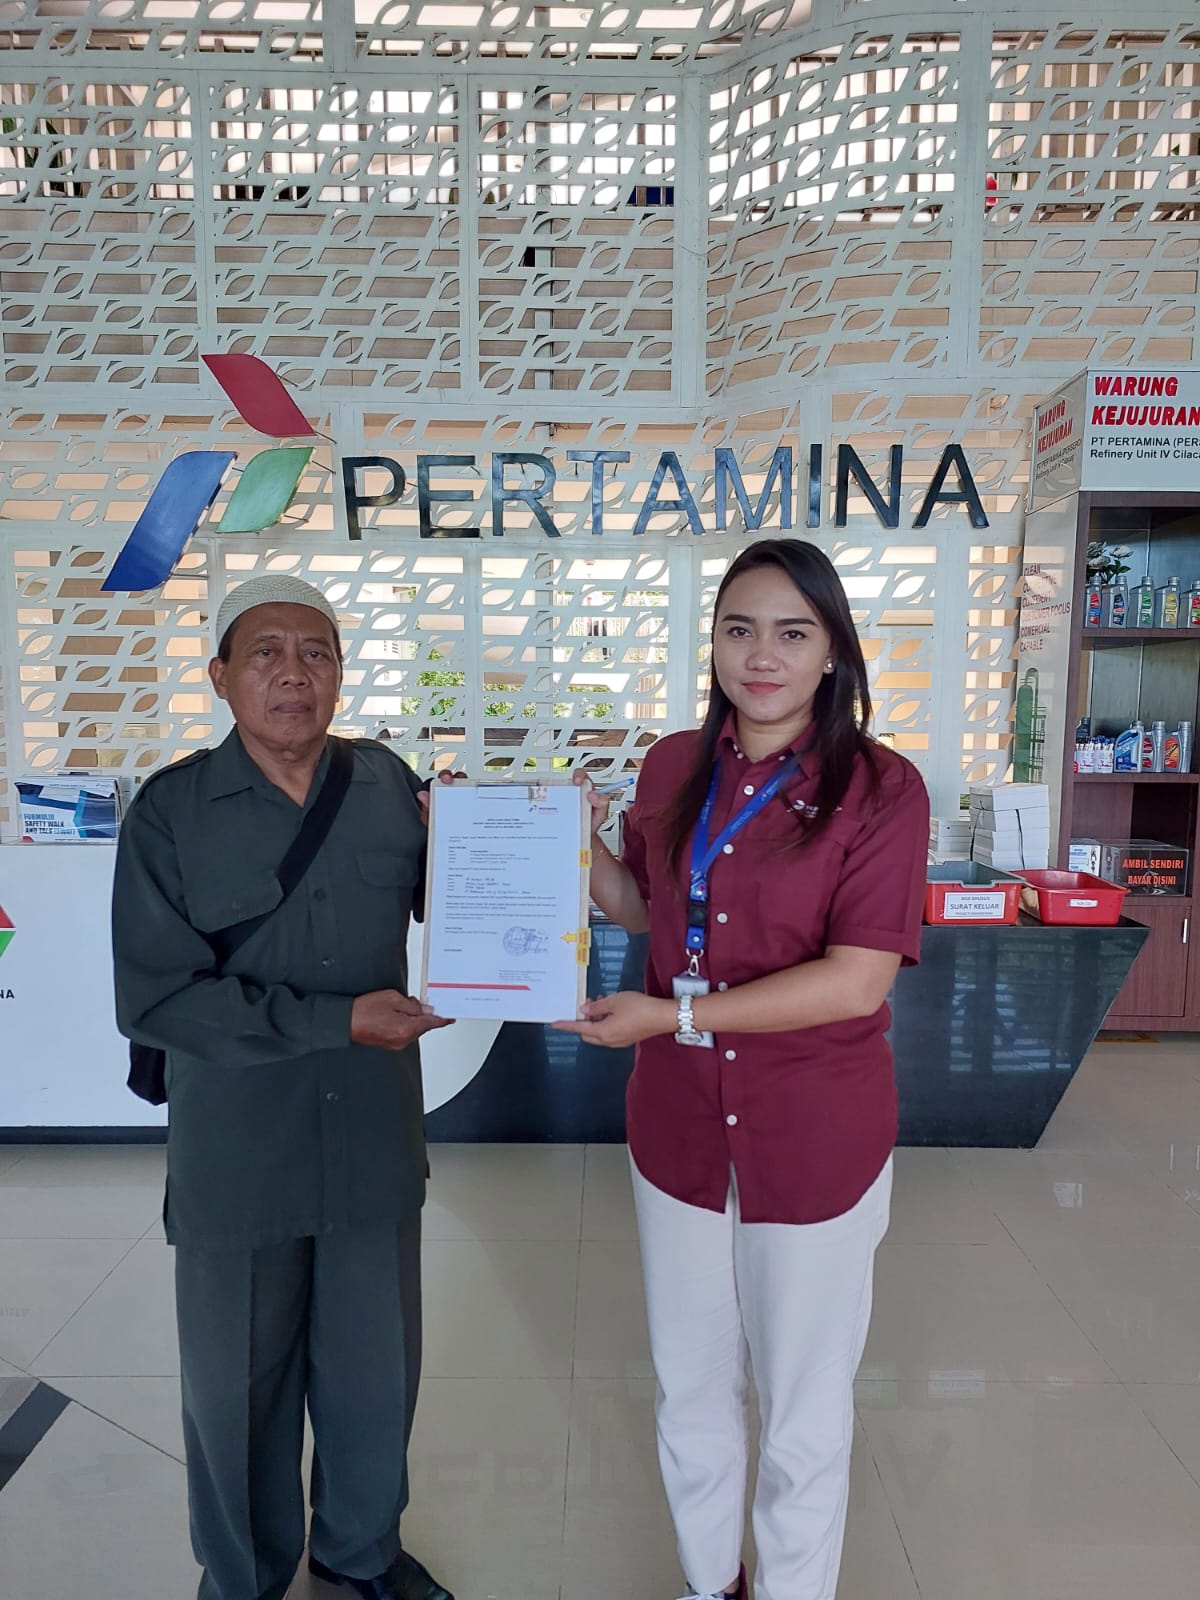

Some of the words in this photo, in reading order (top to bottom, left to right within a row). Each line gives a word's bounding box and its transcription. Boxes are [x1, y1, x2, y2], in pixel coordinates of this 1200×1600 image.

[1095, 376, 1178, 396] WARUNG
[1038, 399, 1066, 432] WARUNG
[1091, 405, 1200, 426] KEJUJURAN
[1037, 416, 1073, 455] KEJUJURAN
[1091, 437, 1104, 446] PT
[1108, 437, 1171, 446] PERTAMINA
[1173, 437, 1200, 448] (PER
[1090, 449, 1133, 460] Refinery
[1136, 449, 1157, 459] Unit
[1160, 449, 1170, 458] IV
[341, 442, 990, 541] PERTAMINA
[1051, 601, 1071, 617] FOCUS
[1122, 858, 1149, 869] AMBIL
[1149, 859, 1184, 869] SENDIRI
[1127, 875, 1152, 885] BAYAR
[1153, 875, 1176, 885] DISINI
